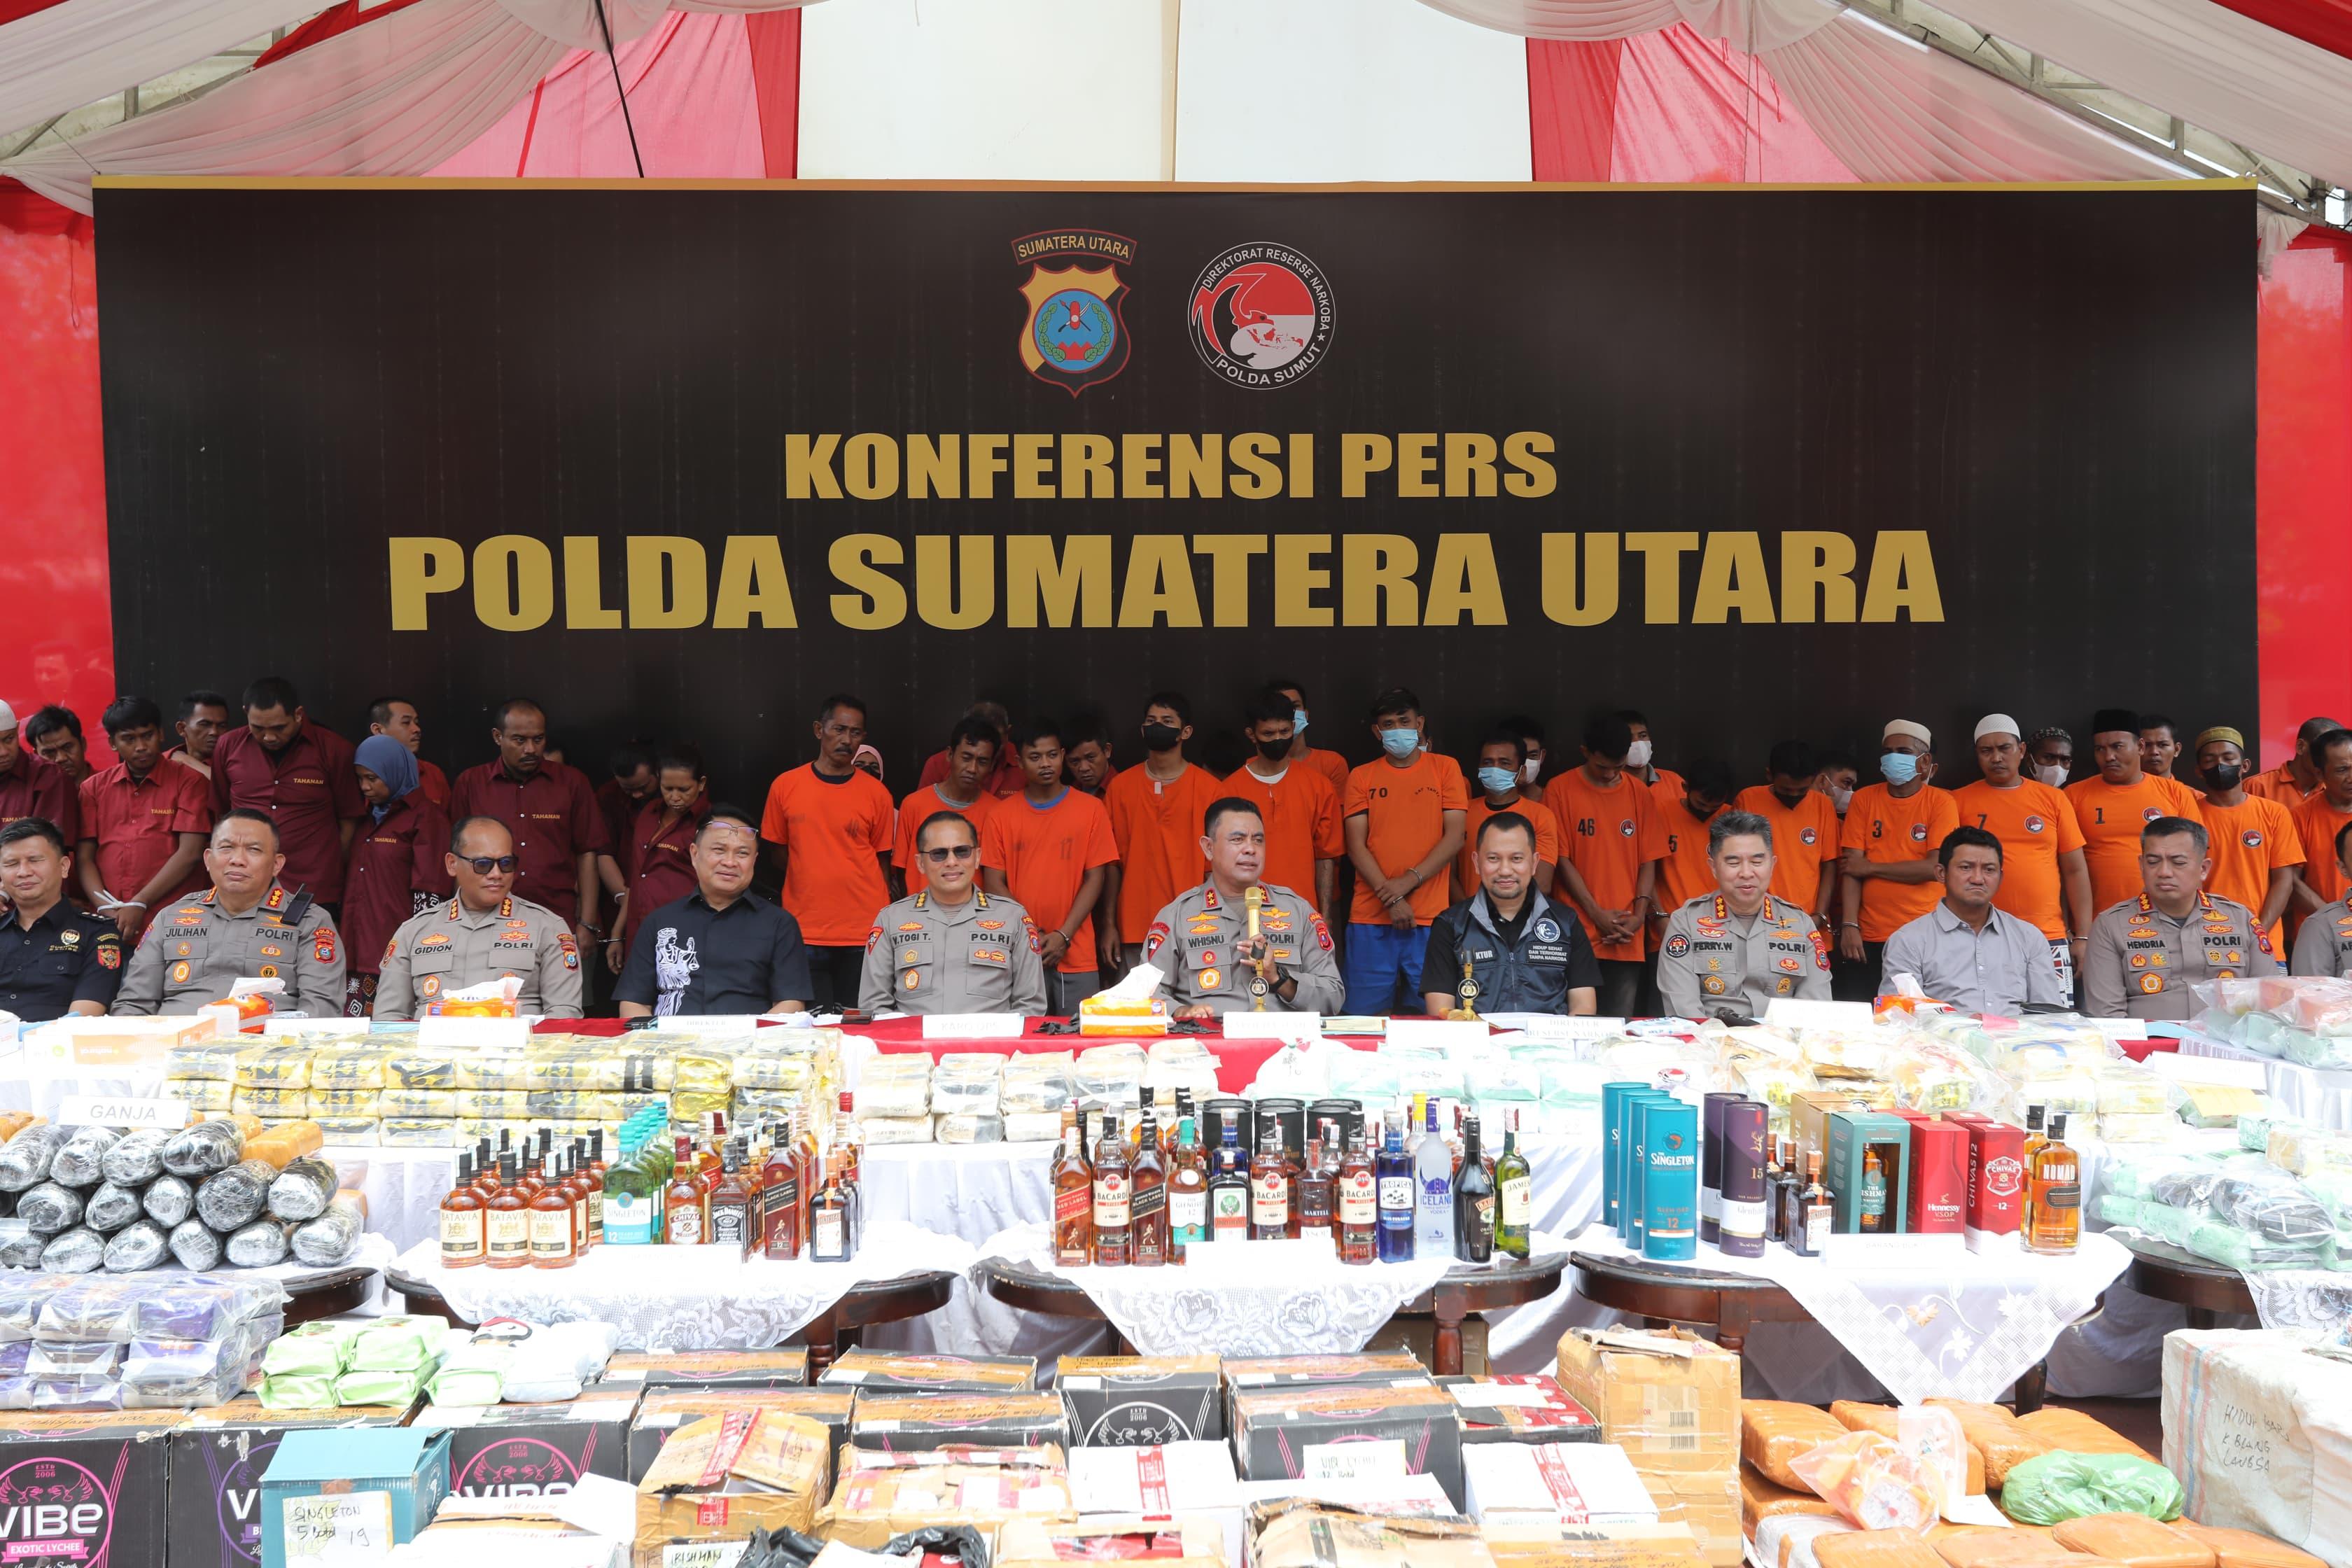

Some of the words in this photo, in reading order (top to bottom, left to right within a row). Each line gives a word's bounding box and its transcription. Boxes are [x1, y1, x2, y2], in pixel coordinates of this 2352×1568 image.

[1018, 235, 1086, 258] SUMATERA
[1088, 237, 1129, 258] UTARA
[1202, 248, 1263, 288] DIREKTORAT
[1266, 248, 1314, 279] RESERSE
[1310, 276, 1331, 331] NARKOBA
[1217, 358, 1270, 384] POLDA
[1274, 342, 1321, 383] SUMUT
[785, 432, 1314, 500] KONFERENSI
[1341, 431, 1557, 498] PERS
[388, 534, 798, 632] POLDA
[828, 533, 1508, 630] SUMATERA
[1541, 530, 1945, 626] UTARA
[1977, 813, 1987, 830] 7
[2095, 808, 2106, 825] 1
[1577, 818, 1595, 836] 46
[1872, 820, 1882, 838] 3
[165, 927, 208, 938] JULIHAN
[255, 927, 293, 941] POLRI
[970, 932, 1010, 945] POLRI
[1187, 934, 1225, 948] WHISNU
[1768, 941, 1806, 953] POLRI
[2127, 939, 2166, 950] HENDRIA
[2204, 935, 2240, 946] POLRI
[414, 944, 453, 955] GIDION
[90, 1104, 157, 1121] GANJA
[1651, 1153, 1695, 1166] SINGLETON
[1751, 1167, 1763, 1180] 15
[2043, 1164, 2076, 1181] NOMAD
[1968, 1159, 1977, 1208] CHIVAS
[1097, 1192, 1129, 1200] BACARDI
[1148, 1193, 1164, 1202] LABEL
[1056, 1202, 1068, 1210] RED
[1069, 1196, 1087, 1206] LABEL
[1927, 1203, 1961, 1212] Hennessy
[1998, 1202, 2008, 1210] 12
[441, 1212, 477, 1221] BATAVIA
[490, 1212, 528, 1221] BATAVIA
[673, 1213, 700, 1222] CHIVAS
[1667, 1217, 1679, 1228] 12
[608, 1231, 617, 1242] 12
[294, 1506, 361, 1523] SINGLETON
[297, 1525, 308, 1540] 5
[10, 1544, 45, 1555] EXOTIC
[46, 1542, 80, 1553] LYCHEE
